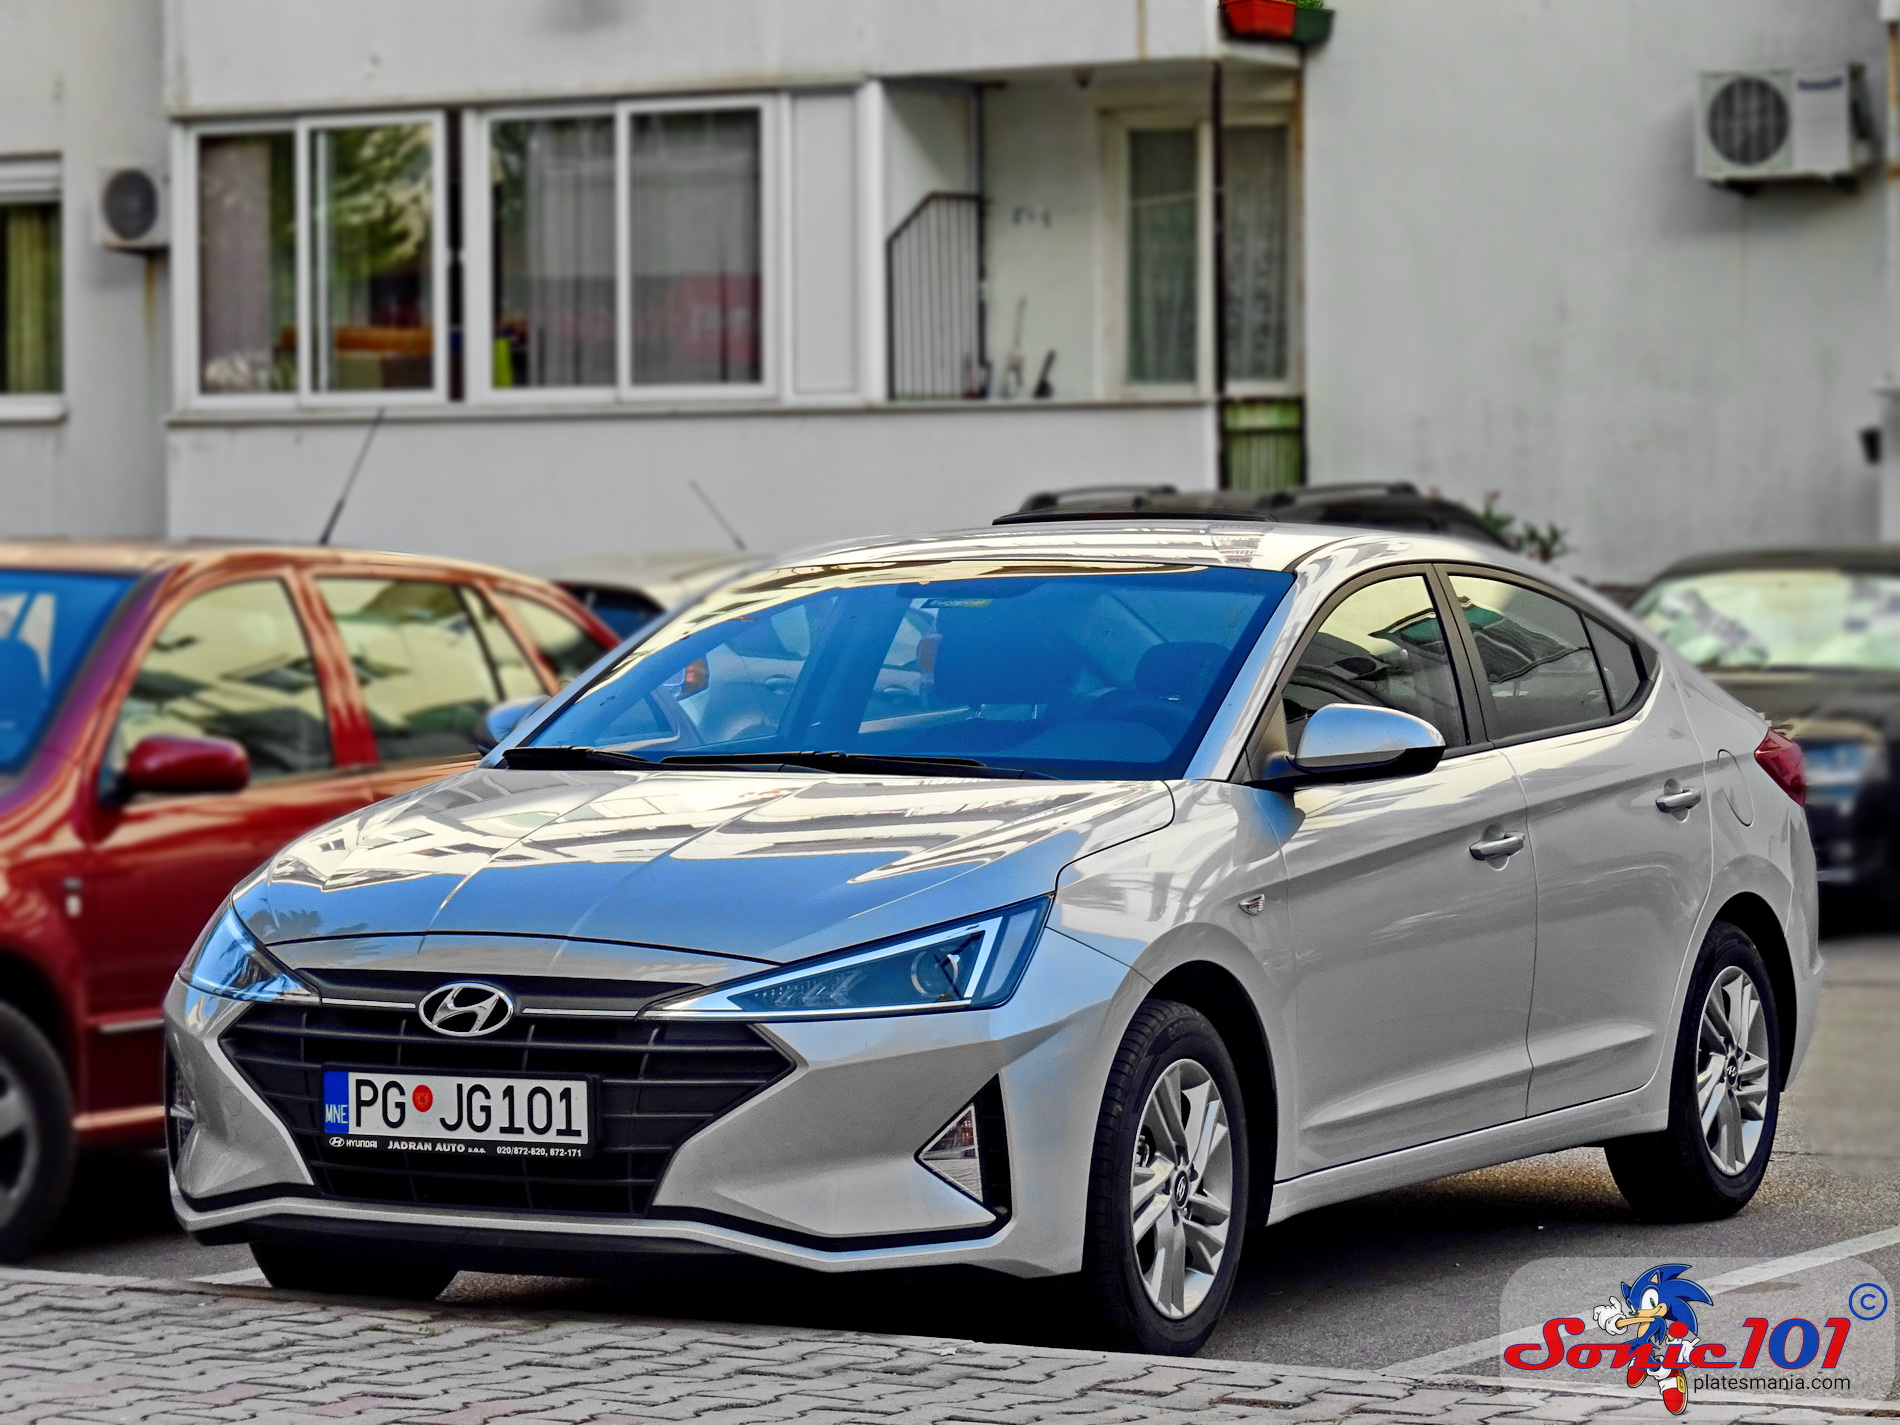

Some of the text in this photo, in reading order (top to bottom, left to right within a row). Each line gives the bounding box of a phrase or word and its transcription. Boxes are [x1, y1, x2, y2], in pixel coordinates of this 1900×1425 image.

[325, 1103, 348, 1124] MNE
[355, 1078, 582, 1137] PG JG101
[346, 1139, 378, 1149] HYUNDAI
[387, 1140, 432, 1151] JADRAN
[435, 1142, 465, 1153] AUTO
[549, 1148, 582, 1158] 872-171
